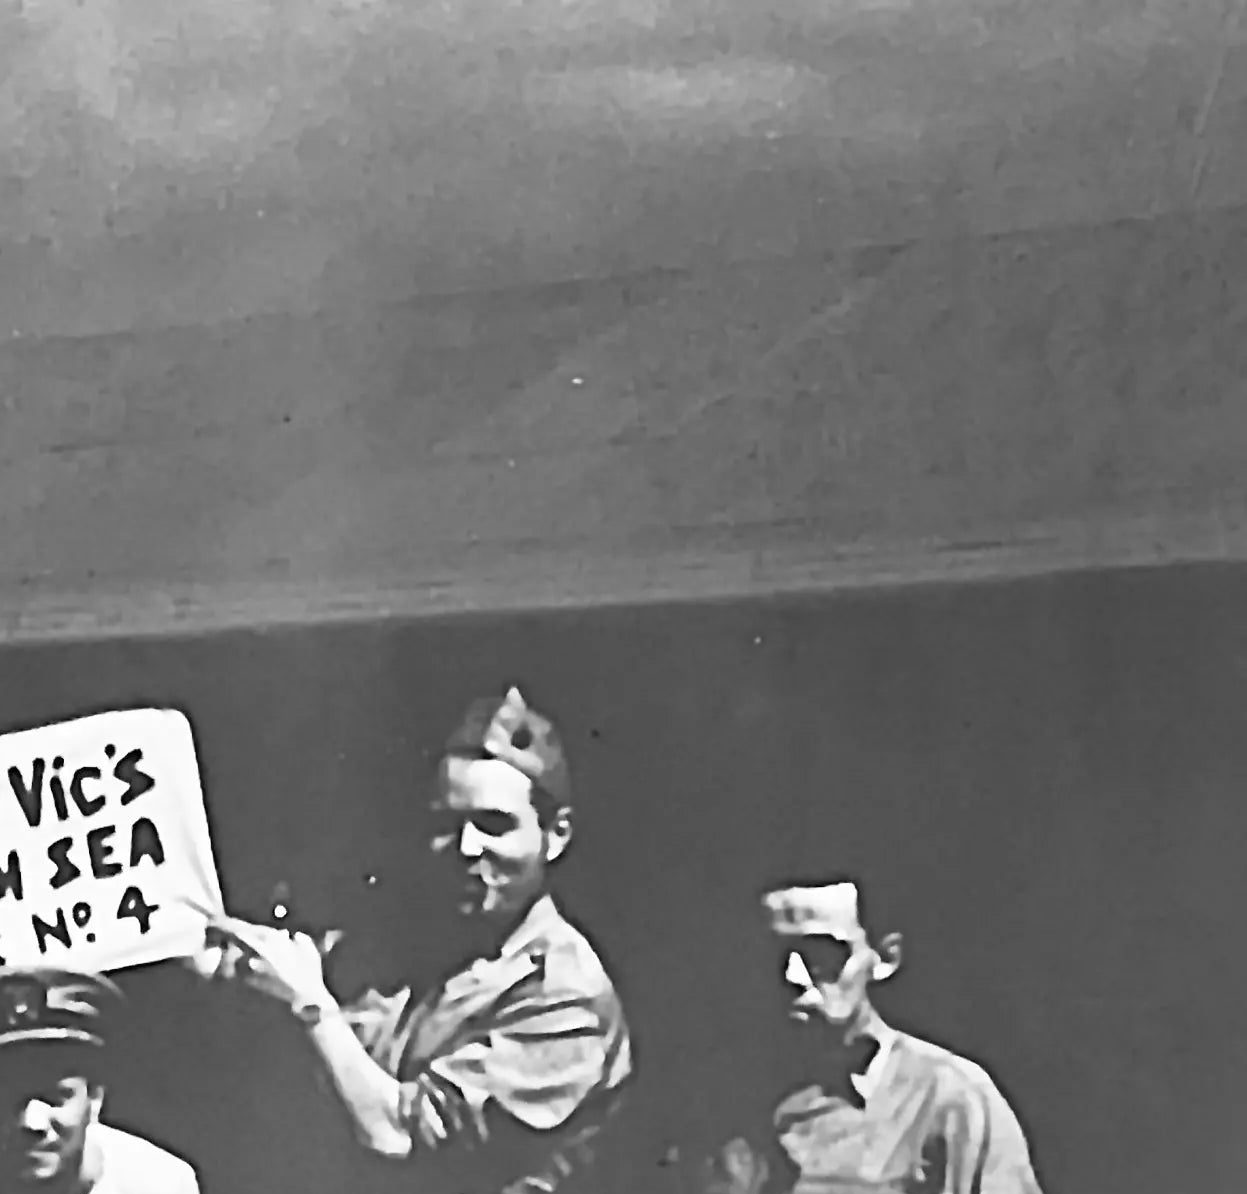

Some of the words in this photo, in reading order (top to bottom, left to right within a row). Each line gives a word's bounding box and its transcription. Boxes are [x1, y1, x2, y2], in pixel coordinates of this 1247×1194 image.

[7, 743, 155, 827] Vic's
[47, 817, 165, 890] SEA
[116, 886, 160, 935] 4
